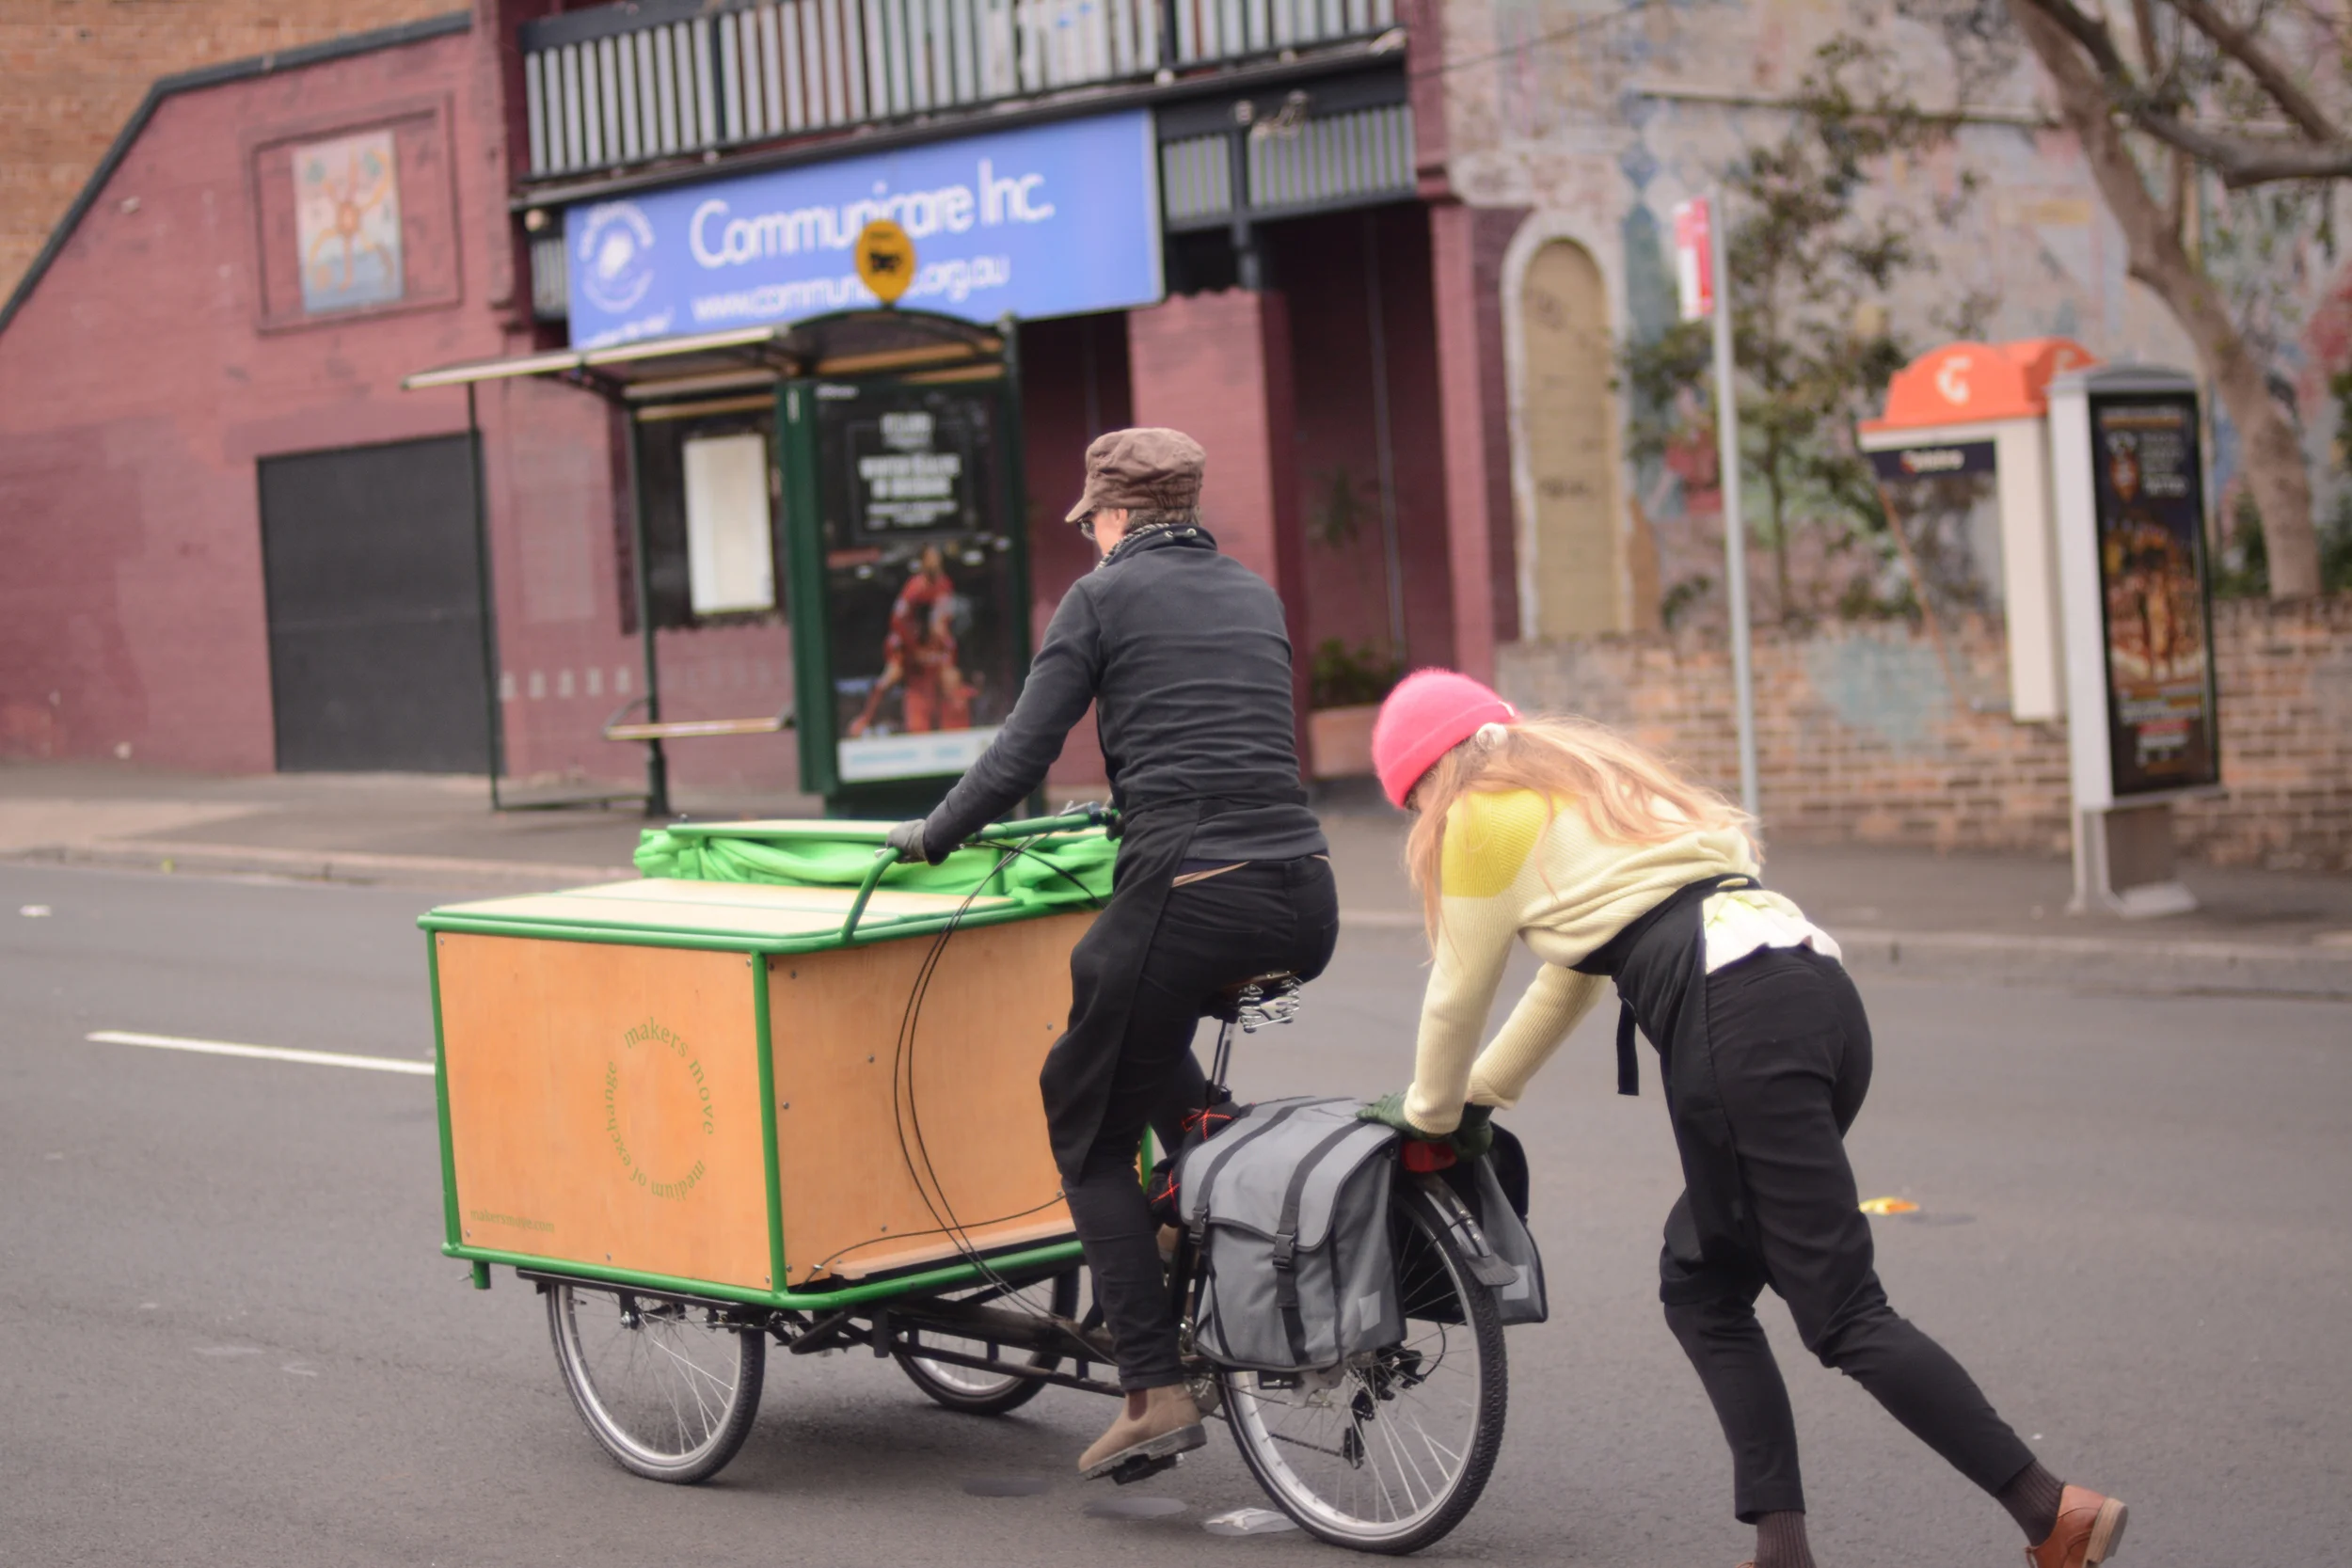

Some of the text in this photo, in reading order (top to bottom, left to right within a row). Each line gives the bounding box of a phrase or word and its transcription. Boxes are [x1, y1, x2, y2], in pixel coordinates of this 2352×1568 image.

[605, 1061, 705, 1202] medium of exchange
[624, 1016, 714, 1135] makers move
